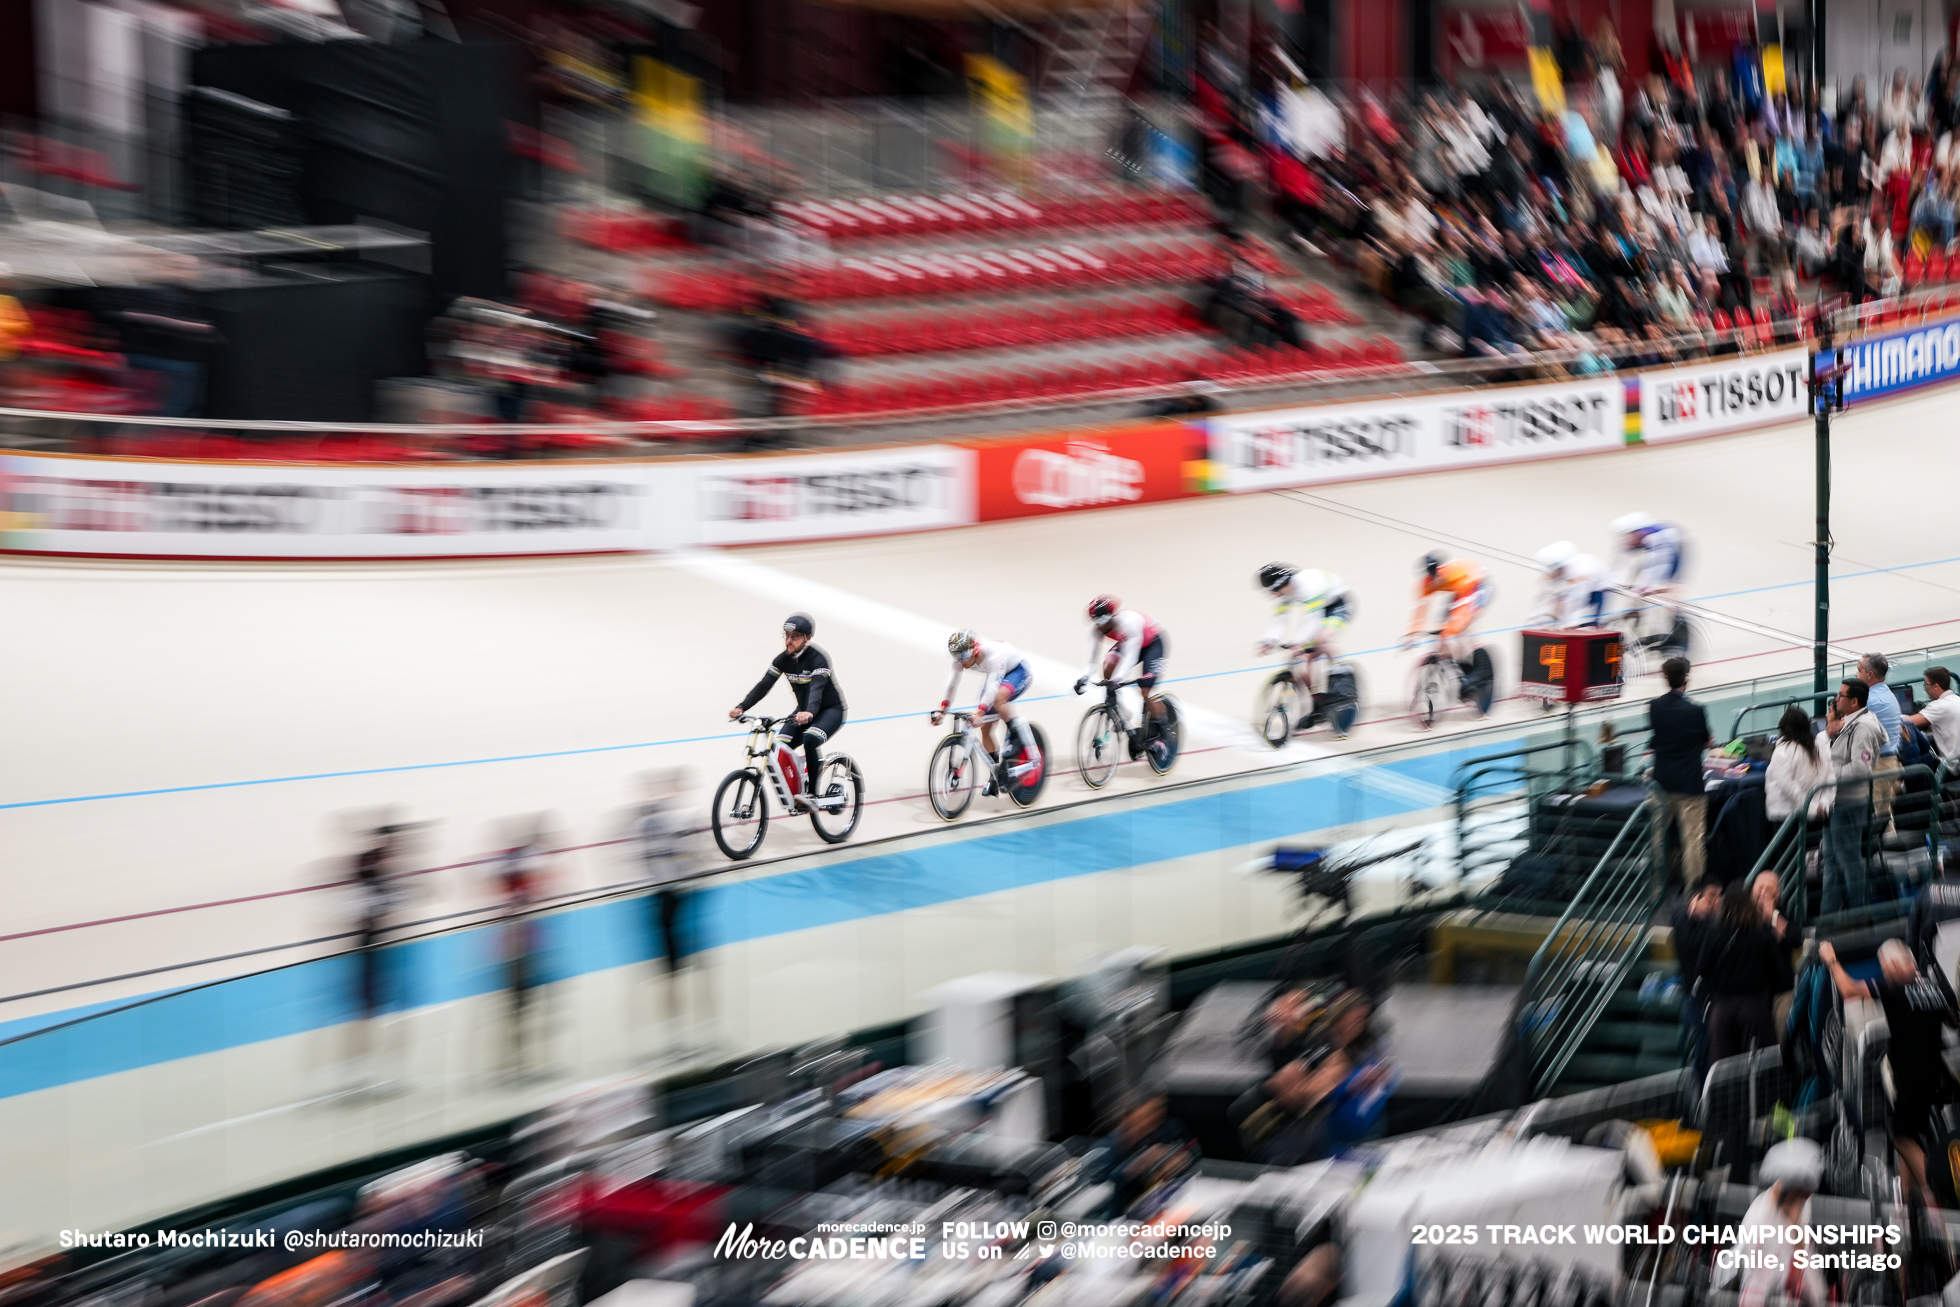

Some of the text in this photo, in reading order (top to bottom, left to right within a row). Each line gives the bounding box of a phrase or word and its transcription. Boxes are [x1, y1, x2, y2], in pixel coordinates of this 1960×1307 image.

[1834, 322, 1960, 396] SHIMANO
[1698, 361, 1804, 418] TISSOT
[1292, 414, 1420, 464] TISSOT
[1493, 393, 1609, 445] TISSOT
